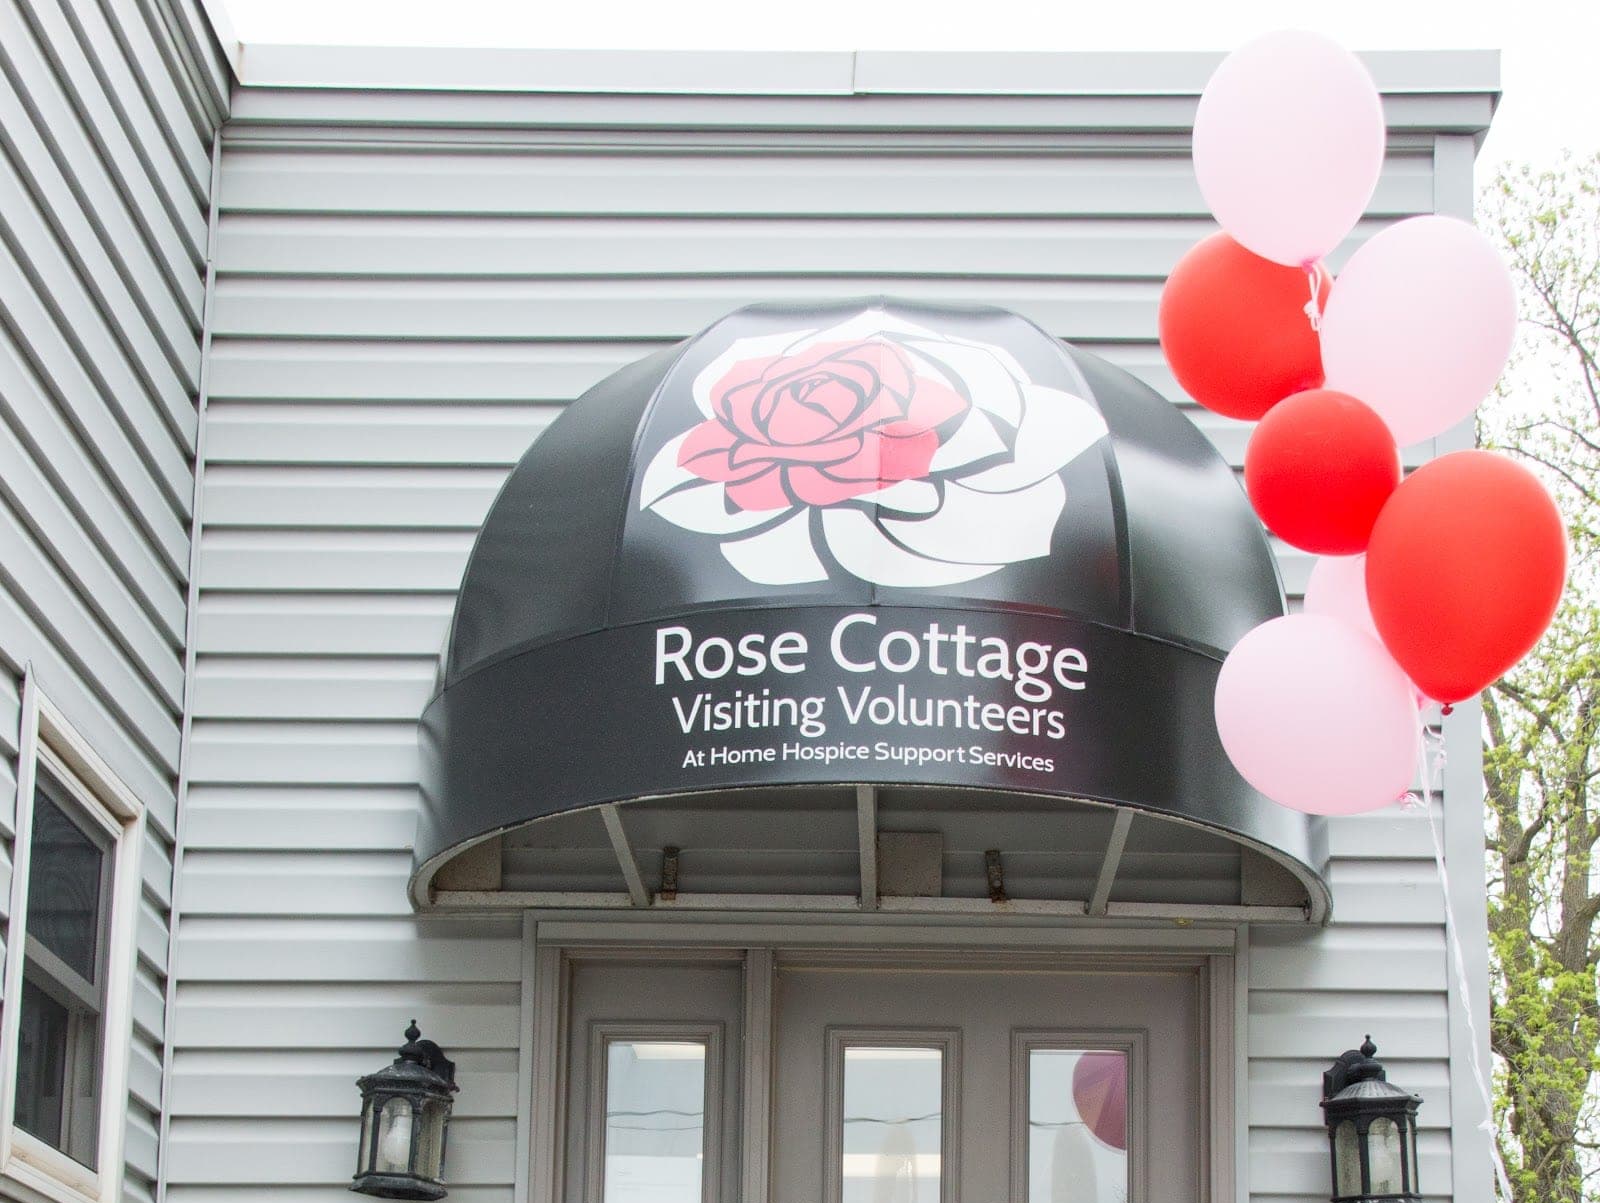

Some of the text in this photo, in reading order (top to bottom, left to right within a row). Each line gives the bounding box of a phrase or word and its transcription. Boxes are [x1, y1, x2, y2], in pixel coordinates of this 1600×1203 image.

[655, 613, 1089, 702] Rose Cottage
[672, 684, 1066, 740] Visiting Volunteers
[681, 741, 1056, 773] At Home Hospice Support Services
